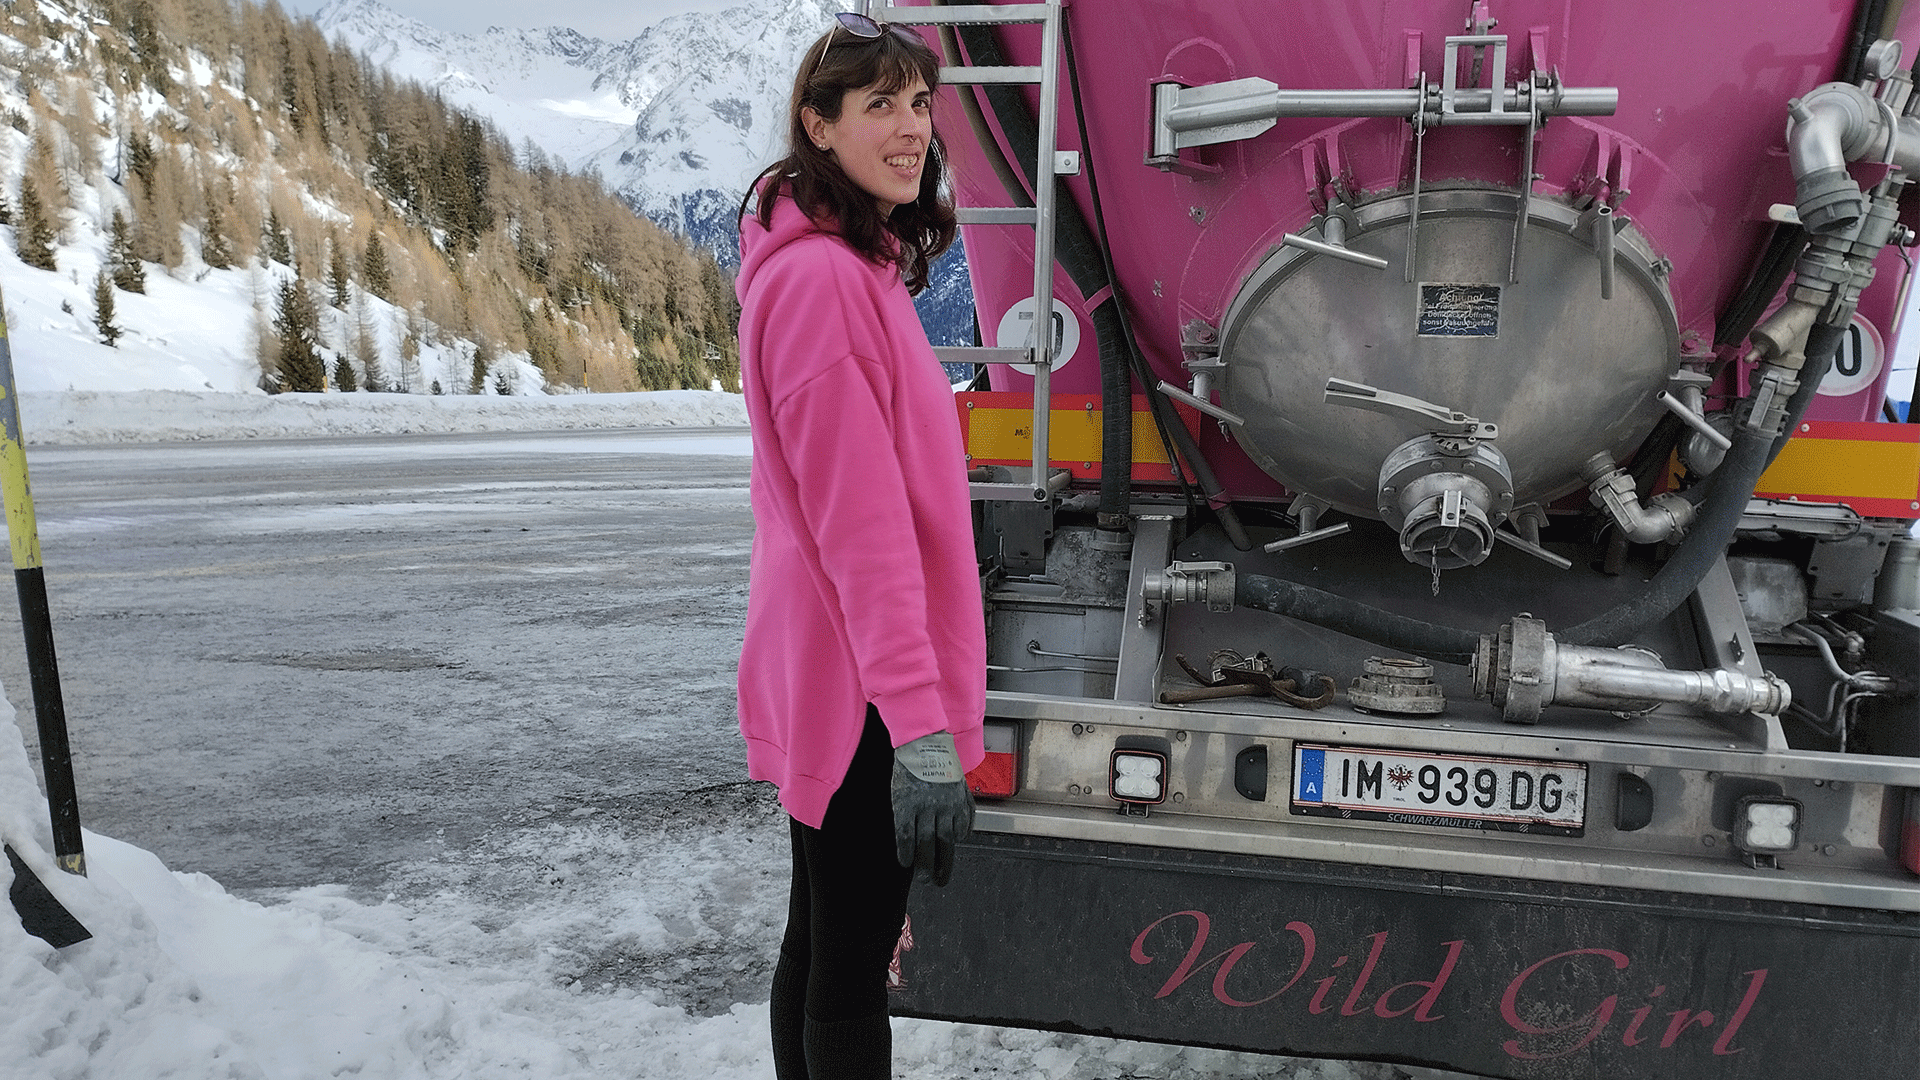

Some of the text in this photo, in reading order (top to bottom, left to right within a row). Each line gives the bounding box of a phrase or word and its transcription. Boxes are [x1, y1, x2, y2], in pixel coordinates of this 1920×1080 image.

[1306, 781, 1317, 794] A
[1341, 758, 1564, 814] IM 939 DG
[1386, 813, 1483, 829] SCHWARZMÜLLER
[1129, 909, 1768, 1060] Wild Girl
